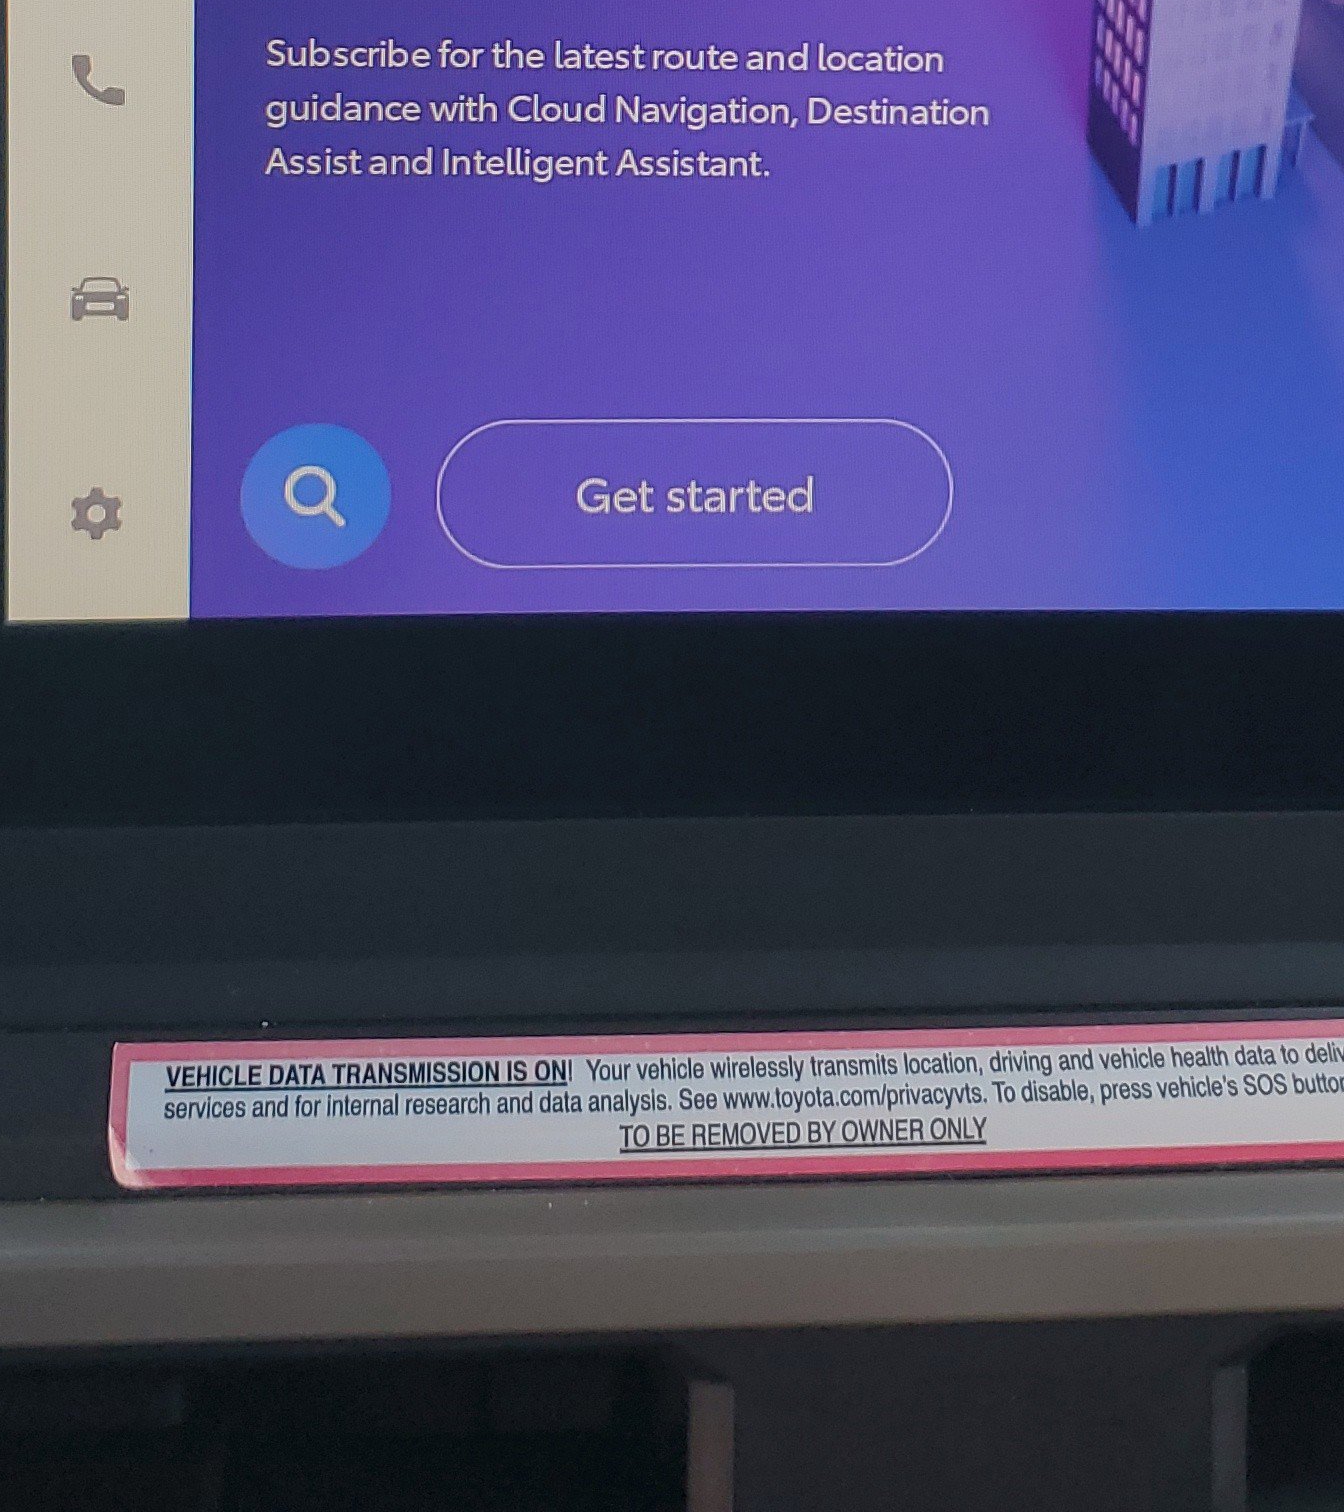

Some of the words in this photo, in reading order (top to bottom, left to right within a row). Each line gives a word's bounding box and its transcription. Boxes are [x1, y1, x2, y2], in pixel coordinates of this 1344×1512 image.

[266, 39, 432, 71] Subscribe
[439, 42, 484, 70] for
[491, 42, 545, 71] the
[555, 42, 646, 72] latest
[652, 45, 739, 72] route
[745, 44, 809, 73] and
[818, 44, 944, 75] location
[265, 94, 422, 131] guidance
[429, 94, 498, 124] with
[507, 95, 606, 125] Cloud
[615, 96, 799, 132] Navigation,
[807, 98, 990, 128] Destination
[265, 147, 363, 177] Assist
[369, 147, 433, 177] and
[442, 148, 609, 184] Intelligent
[616, 149, 770, 179] Assistant.
[576, 478, 655, 514] Get
[665, 477, 814, 514] started
[166, 1065, 262, 1088] VEHICLE
[269, 1064, 325, 1086] DATA
[331, 1060, 500, 1086] TRANSMISSION
[507, 1060, 527, 1083] IS
[534, 1059, 573, 1083] ON!
[586, 1059, 631, 1082] Your
[636, 1058, 704, 1081] vehicle
[711, 1054, 805, 1080] wirelessly
[810, 1052, 898, 1077] transmits
[903, 1051, 983, 1077] location,
[990, 1048, 1053, 1075] driving
[1058, 1048, 1094, 1071] and
[1098, 1046, 1165, 1070] vehicle
[1171, 1044, 1228, 1069] health
[1235, 1043, 1276, 1067] data
[1280, 1043, 1299, 1066] to
[164, 1095, 246, 1120] services
[252, 1094, 288, 1118] and
[293, 1094, 320, 1118] for
[326, 1093, 400, 1117] internal
[405, 1093, 491, 1116] research
[497, 1092, 533, 1115] and
[538, 1090, 582, 1115] data
[588, 1089, 672, 1117] analysis.
[678, 1087, 718, 1111] See
[722, 1081, 988, 1112] www.toyota.com/privacyvts.
[992, 1080, 1016, 1105] To
[1021, 1078, 1095, 1107] disable,
[1100, 1078, 1153, 1105] press
[1158, 1073, 1238, 1099] vehicle's
[1243, 1071, 1287, 1096] SOS
[619, 1124, 651, 1148] TO
[657, 1124, 685, 1147] BE
[691, 1122, 803, 1148] REMOVED
[807, 1119, 836, 1143] BY
[841, 1119, 924, 1143] OWNER
[929, 1116, 986, 1141] ONLY
